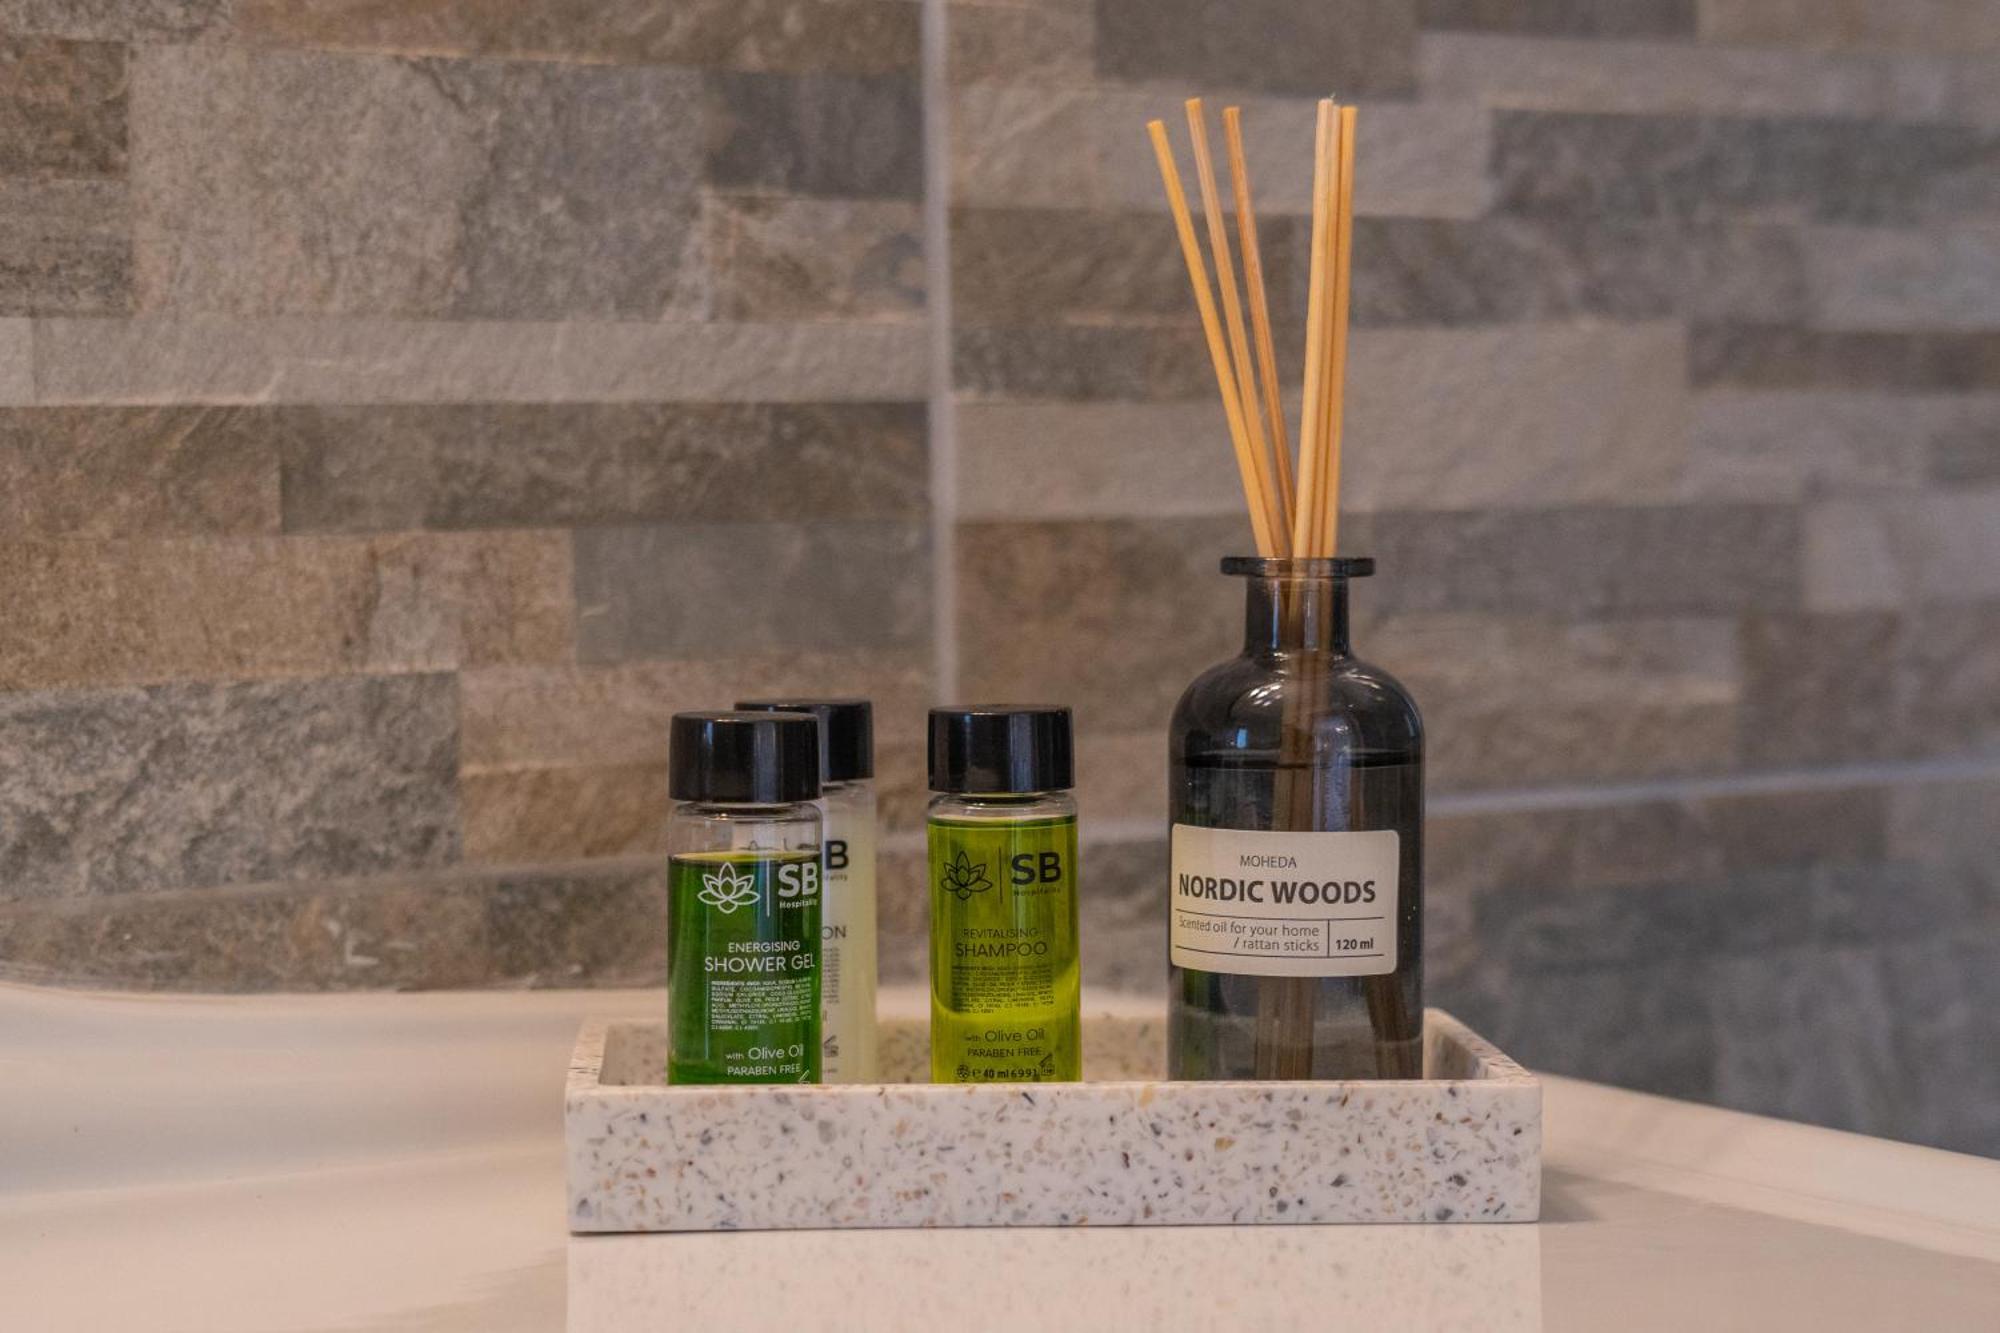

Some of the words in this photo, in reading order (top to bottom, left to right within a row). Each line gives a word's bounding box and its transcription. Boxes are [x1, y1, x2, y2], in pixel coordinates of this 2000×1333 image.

[825, 841, 849, 870] B
[1240, 855, 1297, 869] MOHEDA
[1011, 852, 1061, 885] SB
[778, 862, 818, 897] SB
[1179, 873, 1264, 903] NORDIC
[1271, 880, 1376, 904] WOODS
[1178, 915, 1211, 932] Scented
[1212, 919, 1228, 933] oil
[1230, 921, 1246, 934] for
[1249, 924, 1278, 937] your
[1282, 923, 1320, 937] home
[963, 928, 1039, 939] REVITALISING
[728, 940, 801, 953] ENERGISING
[955, 941, 1048, 958] SHAMPOO
[1243, 938, 1280, 951] rattan
[1284, 939, 1320, 951] sticks
[1335, 939, 1358, 950] 120
[1360, 938, 1374, 950] ml
[704, 956, 787, 973] SHOWER
[791, 953, 815, 970] GEL
[985, 1029, 1022, 1042] Olive
[1026, 1028, 1045, 1041] Oil
[726, 1051, 744, 1060] with
[748, 1046, 785, 1060] Olive
[788, 1044, 804, 1058] Oil
[967, 1047, 1015, 1058] PARABEN
[1018, 1046, 1042, 1057] FREE
[727, 1065, 778, 1076] PARABEN
[779, 1063, 801, 1074] FREE
[997, 1068, 1009, 1079] ml
